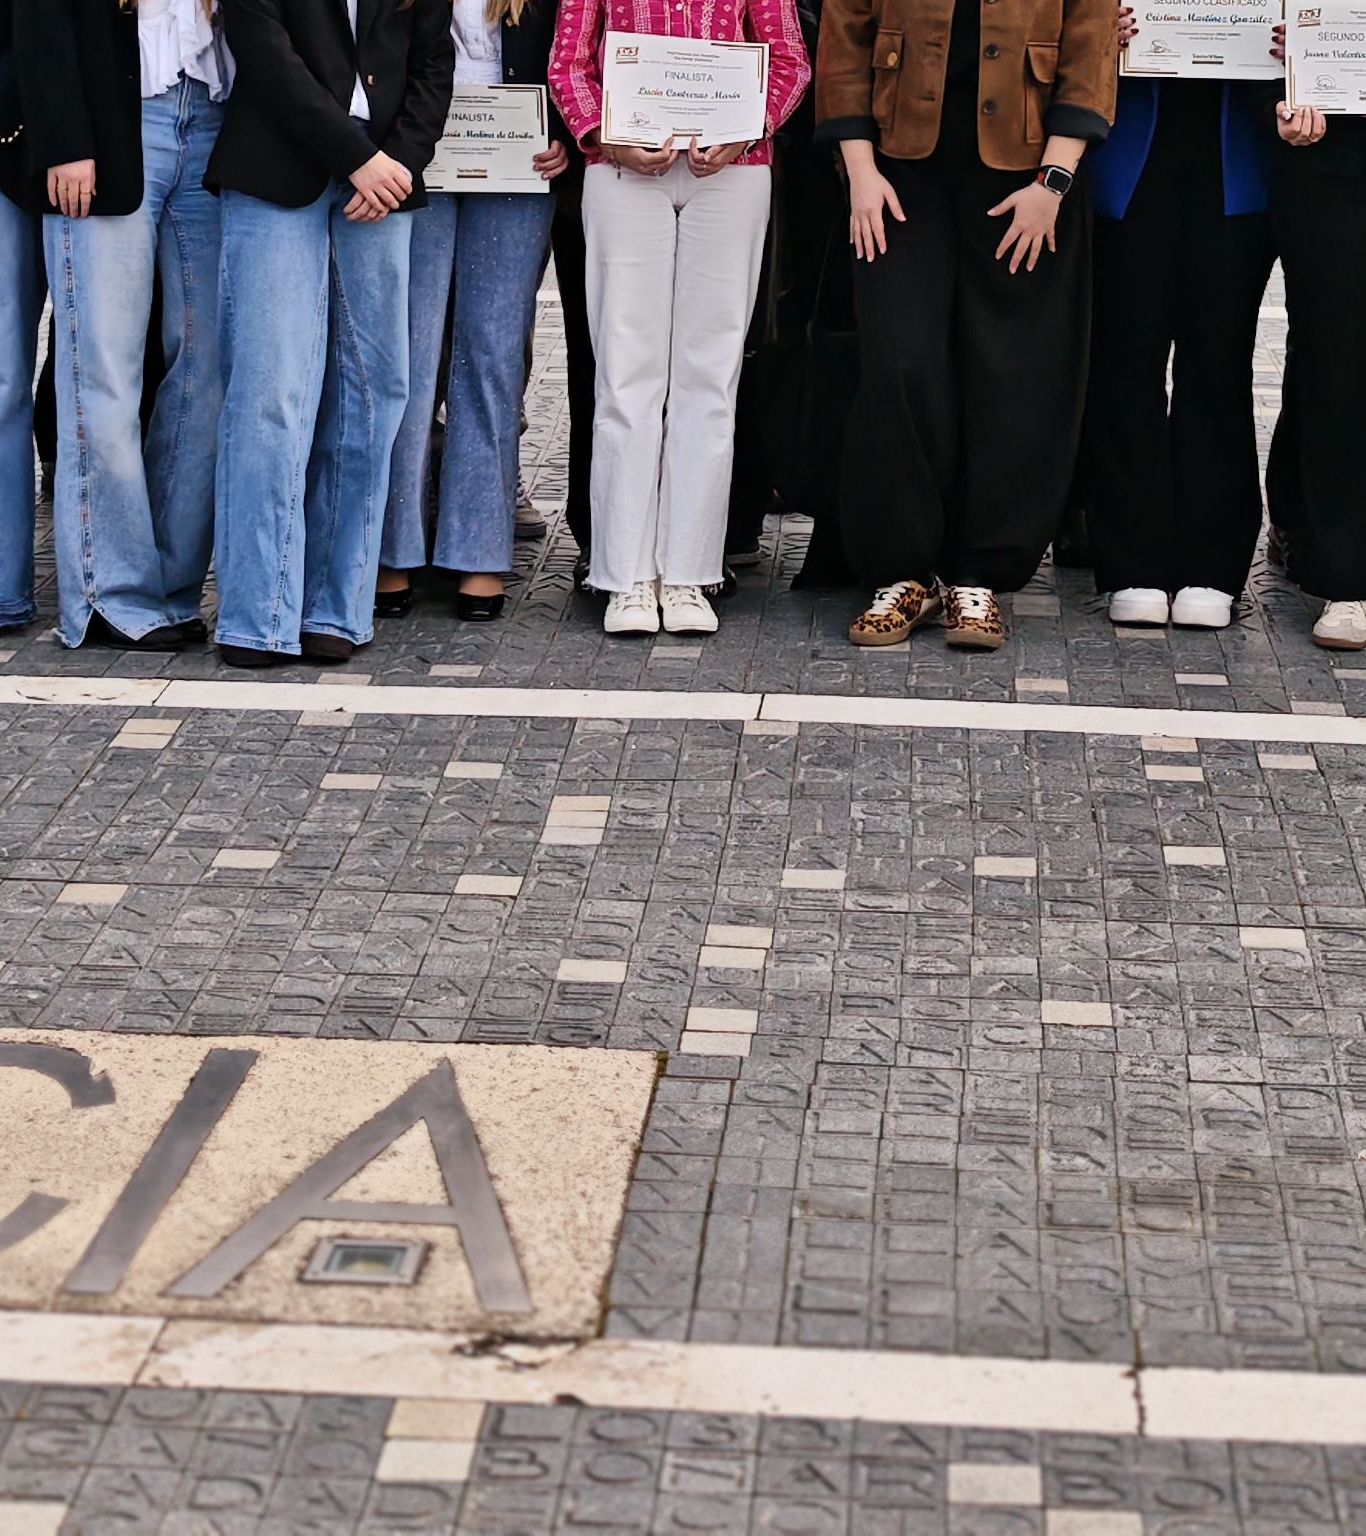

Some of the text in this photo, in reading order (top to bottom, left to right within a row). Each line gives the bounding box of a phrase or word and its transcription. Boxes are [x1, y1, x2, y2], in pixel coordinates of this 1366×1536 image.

[1145, 12, 1181, 22] Cristina
[1318, 32, 1365, 42] SEGUNDO
[665, 71, 714, 83] FINALISTA
[666, 88, 709, 100] Contreras
